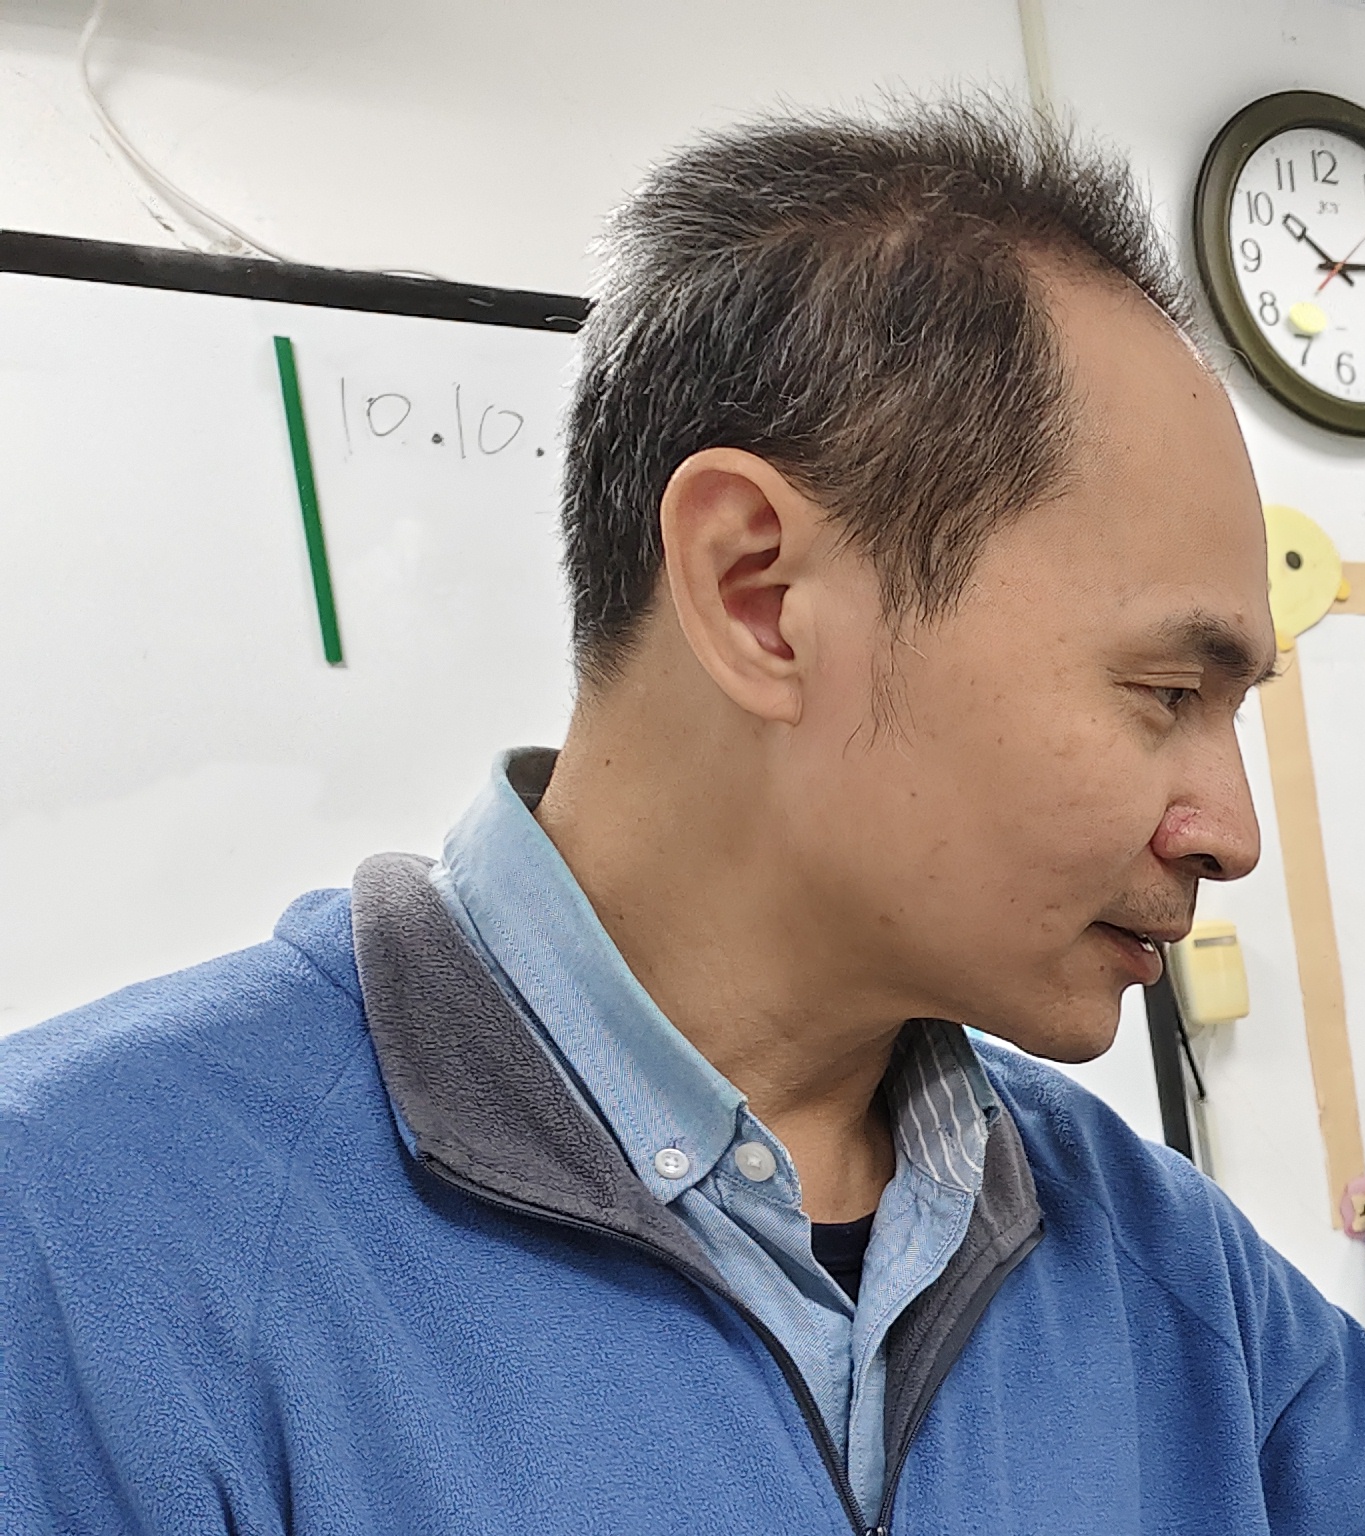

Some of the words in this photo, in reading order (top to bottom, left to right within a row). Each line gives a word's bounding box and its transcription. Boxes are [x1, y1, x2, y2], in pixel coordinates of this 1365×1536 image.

[1275, 157, 1295, 192] 11
[1311, 150, 1339, 185] 12
[1247, 190, 1274, 226] 10
[1240, 238, 1262, 272] 9
[1259, 291, 1279, 326] 8
[1294, 332, 1313, 366] 7
[1336, 352, 1356, 385] 6
